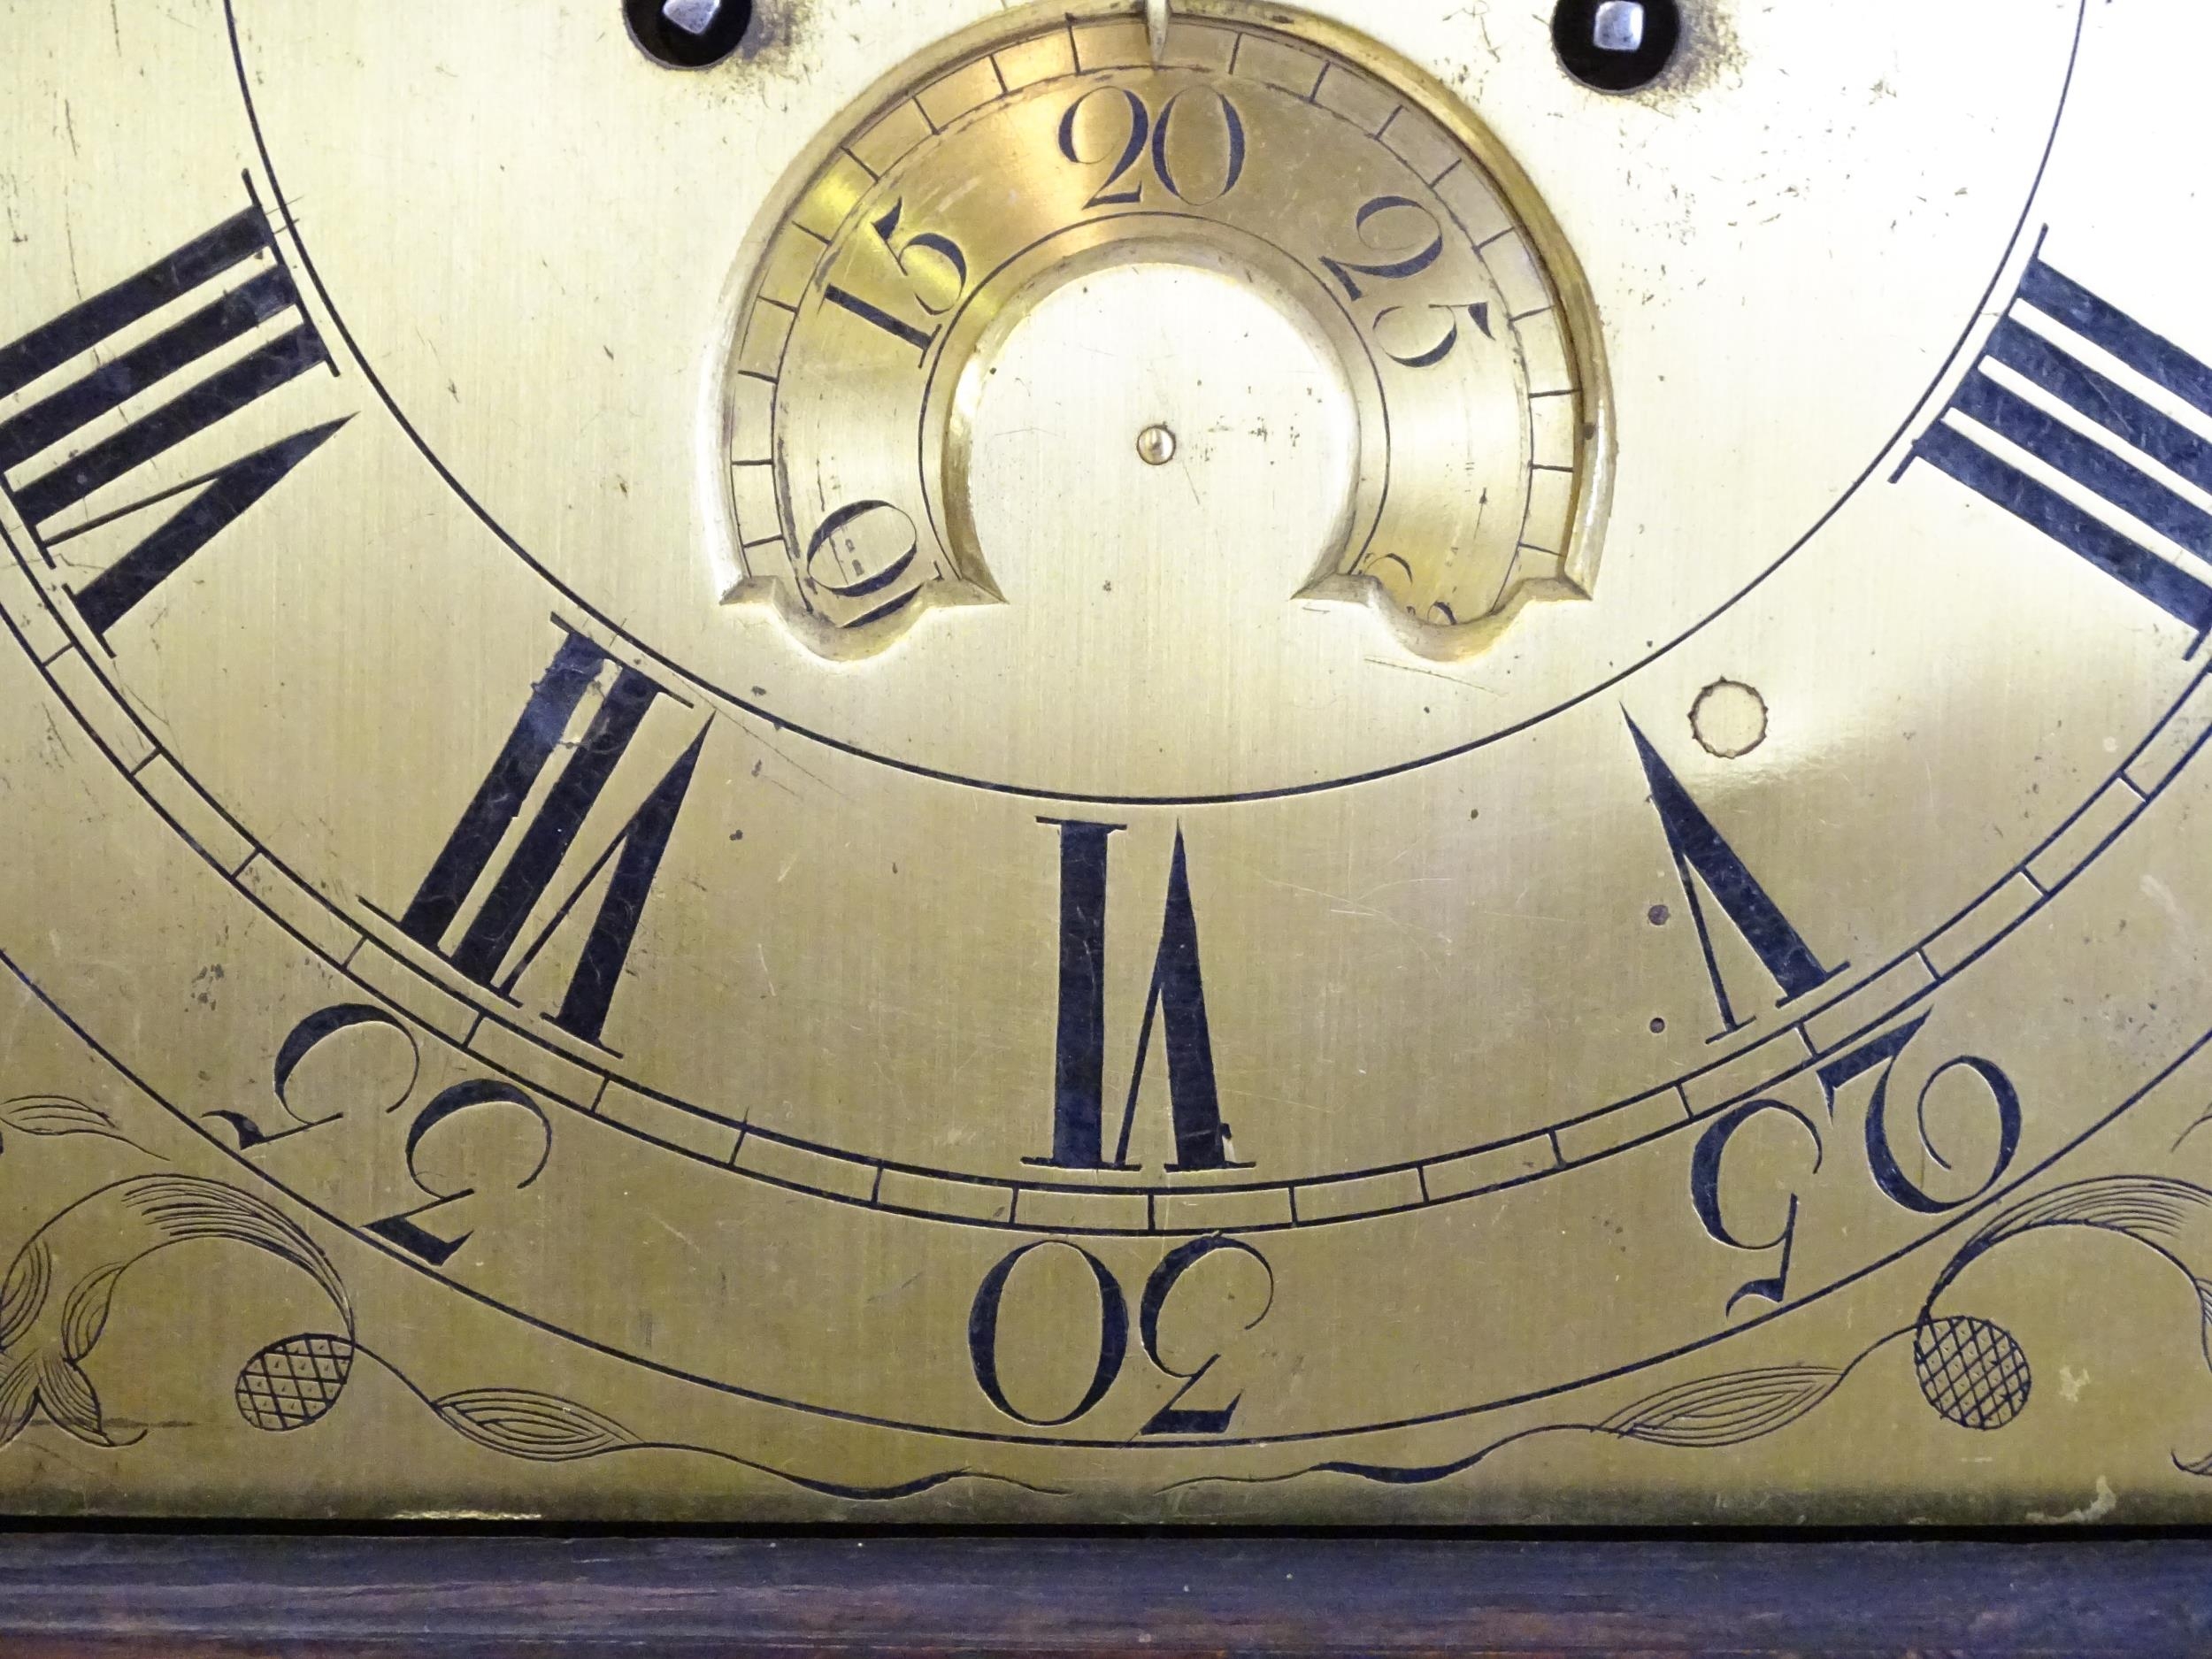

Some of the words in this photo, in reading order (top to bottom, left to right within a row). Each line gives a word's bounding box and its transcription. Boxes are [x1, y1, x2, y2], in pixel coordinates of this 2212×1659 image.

[1058, 84, 1247, 209] 20
[817, 196, 967, 369] 15
[1318, 195, 1496, 368] 25
[357, 611, 718, 1059] VII
[1619, 700, 1851, 1045] V
[1020, 815, 1257, 1173] VI
[201, 1002, 553, 1267] 35
[1691, 1004, 2023, 1319] 25
[968, 1233, 1275, 1436] 30
